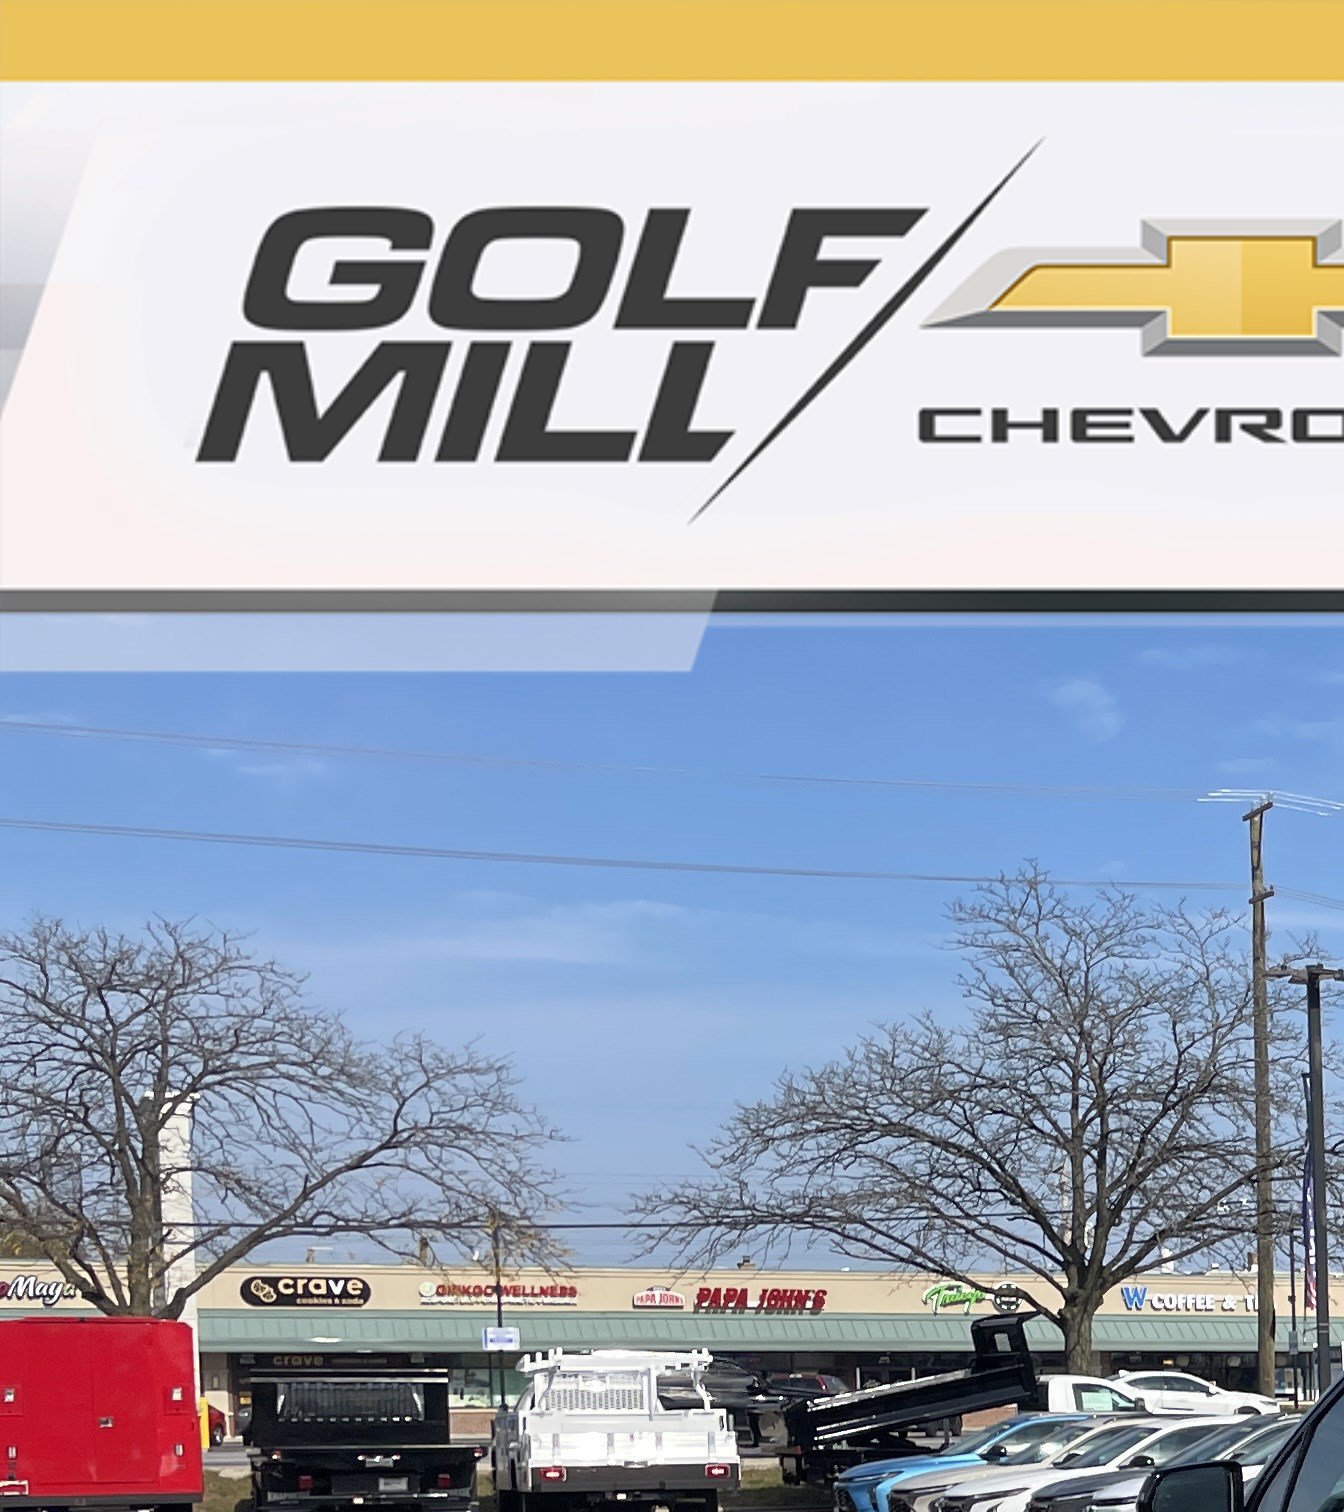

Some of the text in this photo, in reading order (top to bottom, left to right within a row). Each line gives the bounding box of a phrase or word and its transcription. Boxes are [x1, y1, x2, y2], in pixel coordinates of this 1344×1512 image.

[7, 1274, 76, 1306] Maya
[278, 1278, 363, 1296] crave
[695, 1287, 828, 1312] PAPA JOHN'S
[1151, 1293, 1214, 1311] COFFEE
[1221, 1294, 1236, 1311] &
